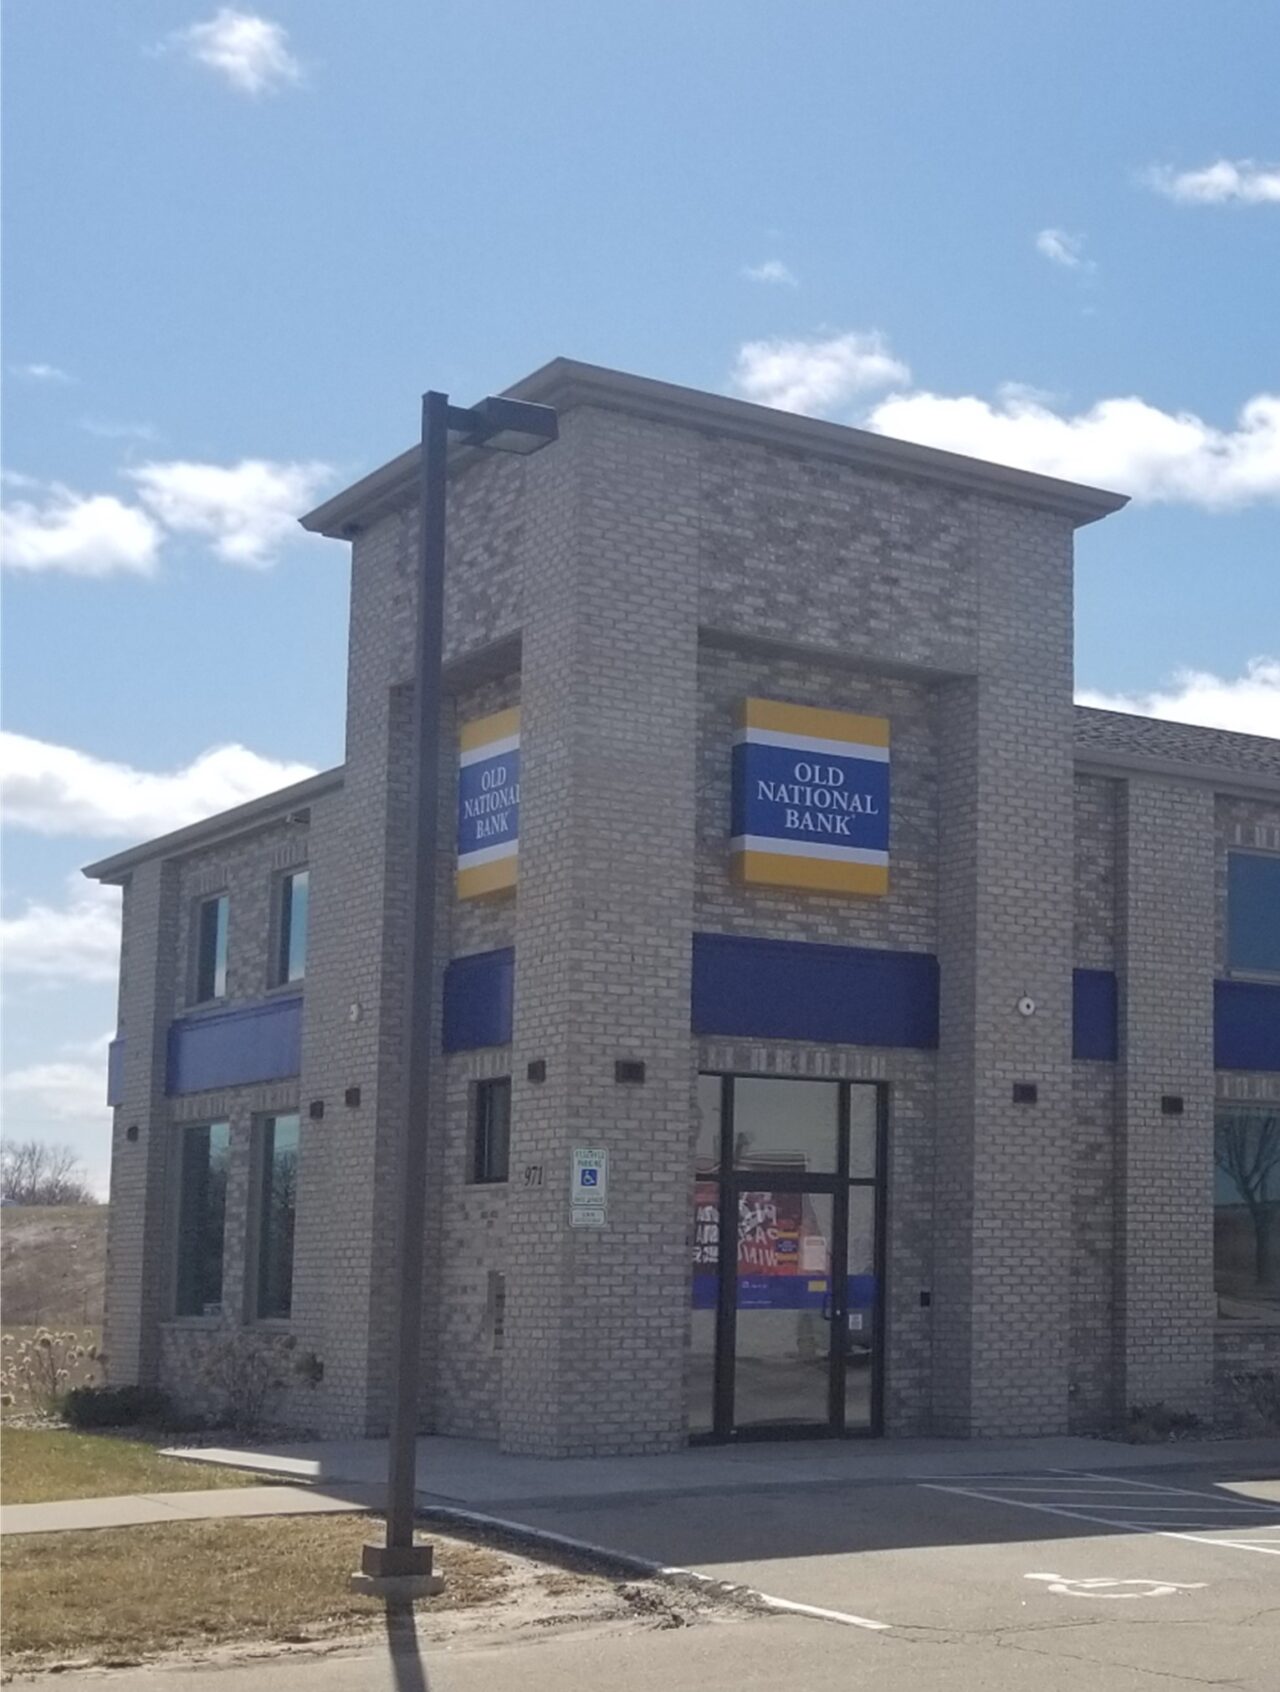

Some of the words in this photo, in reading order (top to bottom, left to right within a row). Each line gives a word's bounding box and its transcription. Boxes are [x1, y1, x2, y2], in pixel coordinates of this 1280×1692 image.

[481, 766, 506, 791] OLD
[794, 762, 844, 787] OLD
[757, 780, 879, 815] NATIONAL
[476, 810, 508, 839] BANK
[785, 808, 851, 835] BANK
[525, 1165, 543, 1186] 971
